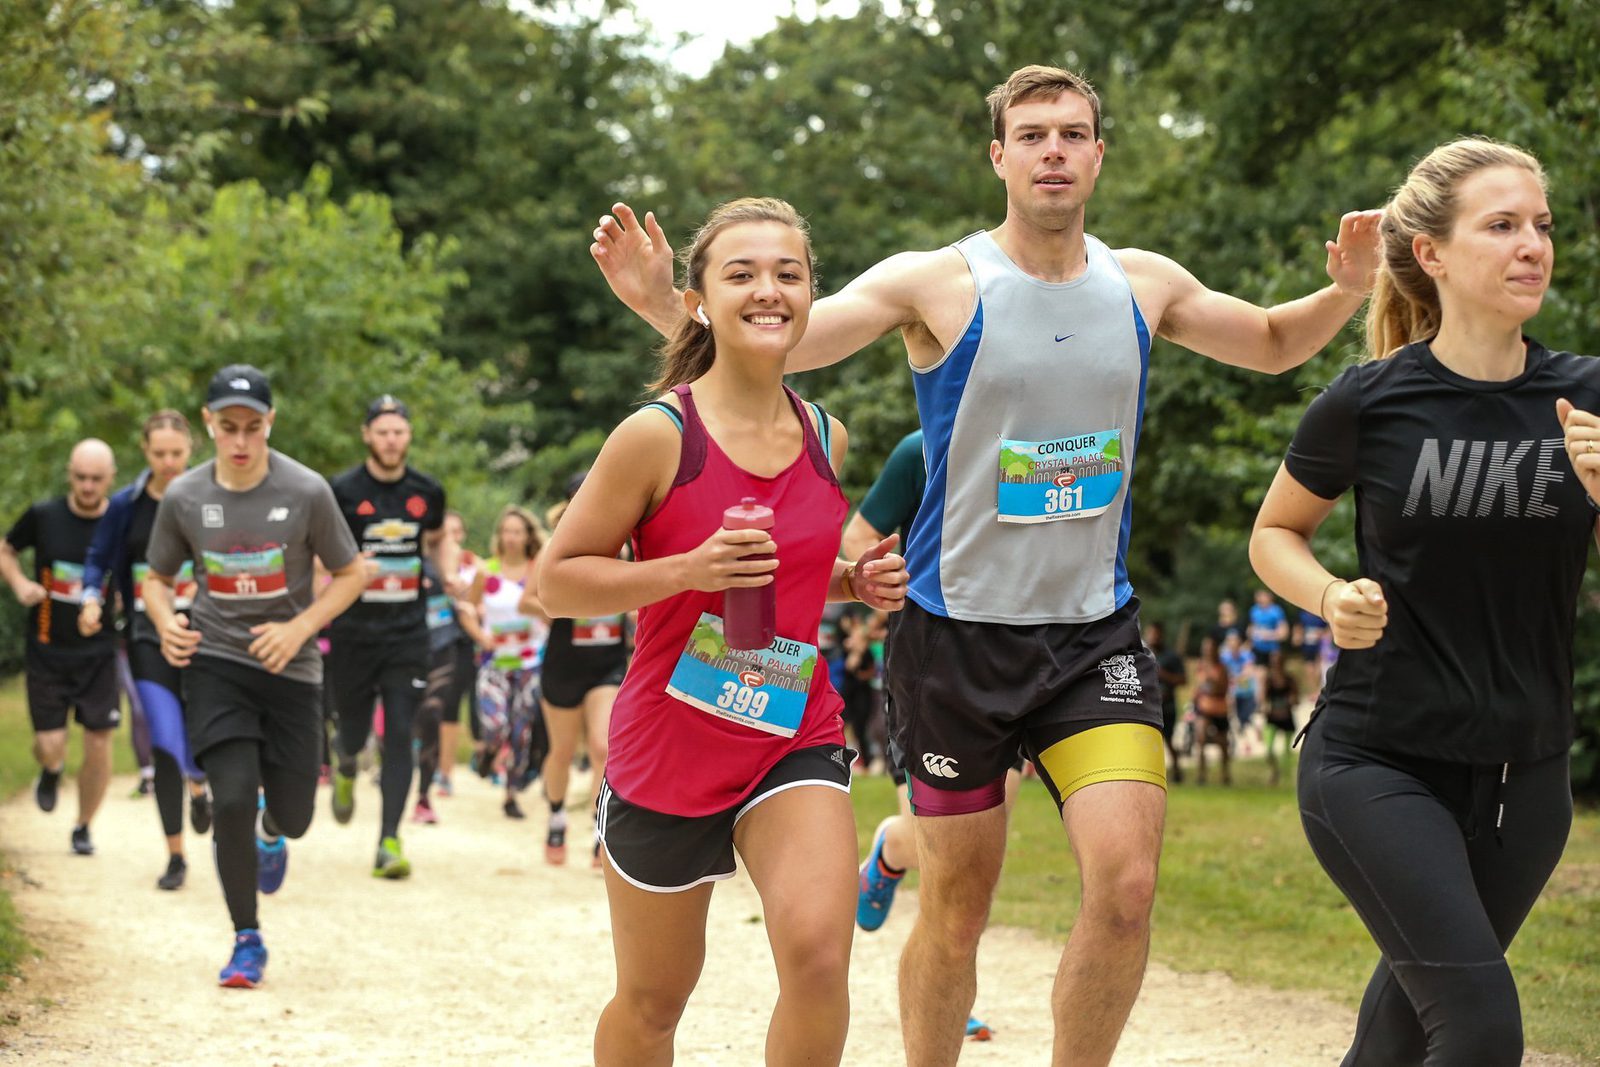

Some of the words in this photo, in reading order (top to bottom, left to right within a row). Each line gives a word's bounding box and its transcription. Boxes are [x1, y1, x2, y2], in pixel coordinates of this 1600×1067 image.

[1037, 436, 1096, 455] CONQUER
[1028, 458, 1070, 470] CRYSTAL
[1072, 452, 1106, 464] PALACE
[1402, 438, 1565, 517] NIKE
[1044, 485, 1083, 513] 361
[720, 644, 764, 665] CRYSTAL
[767, 658, 801, 675] PALACE
[716, 681, 769, 718] 399
